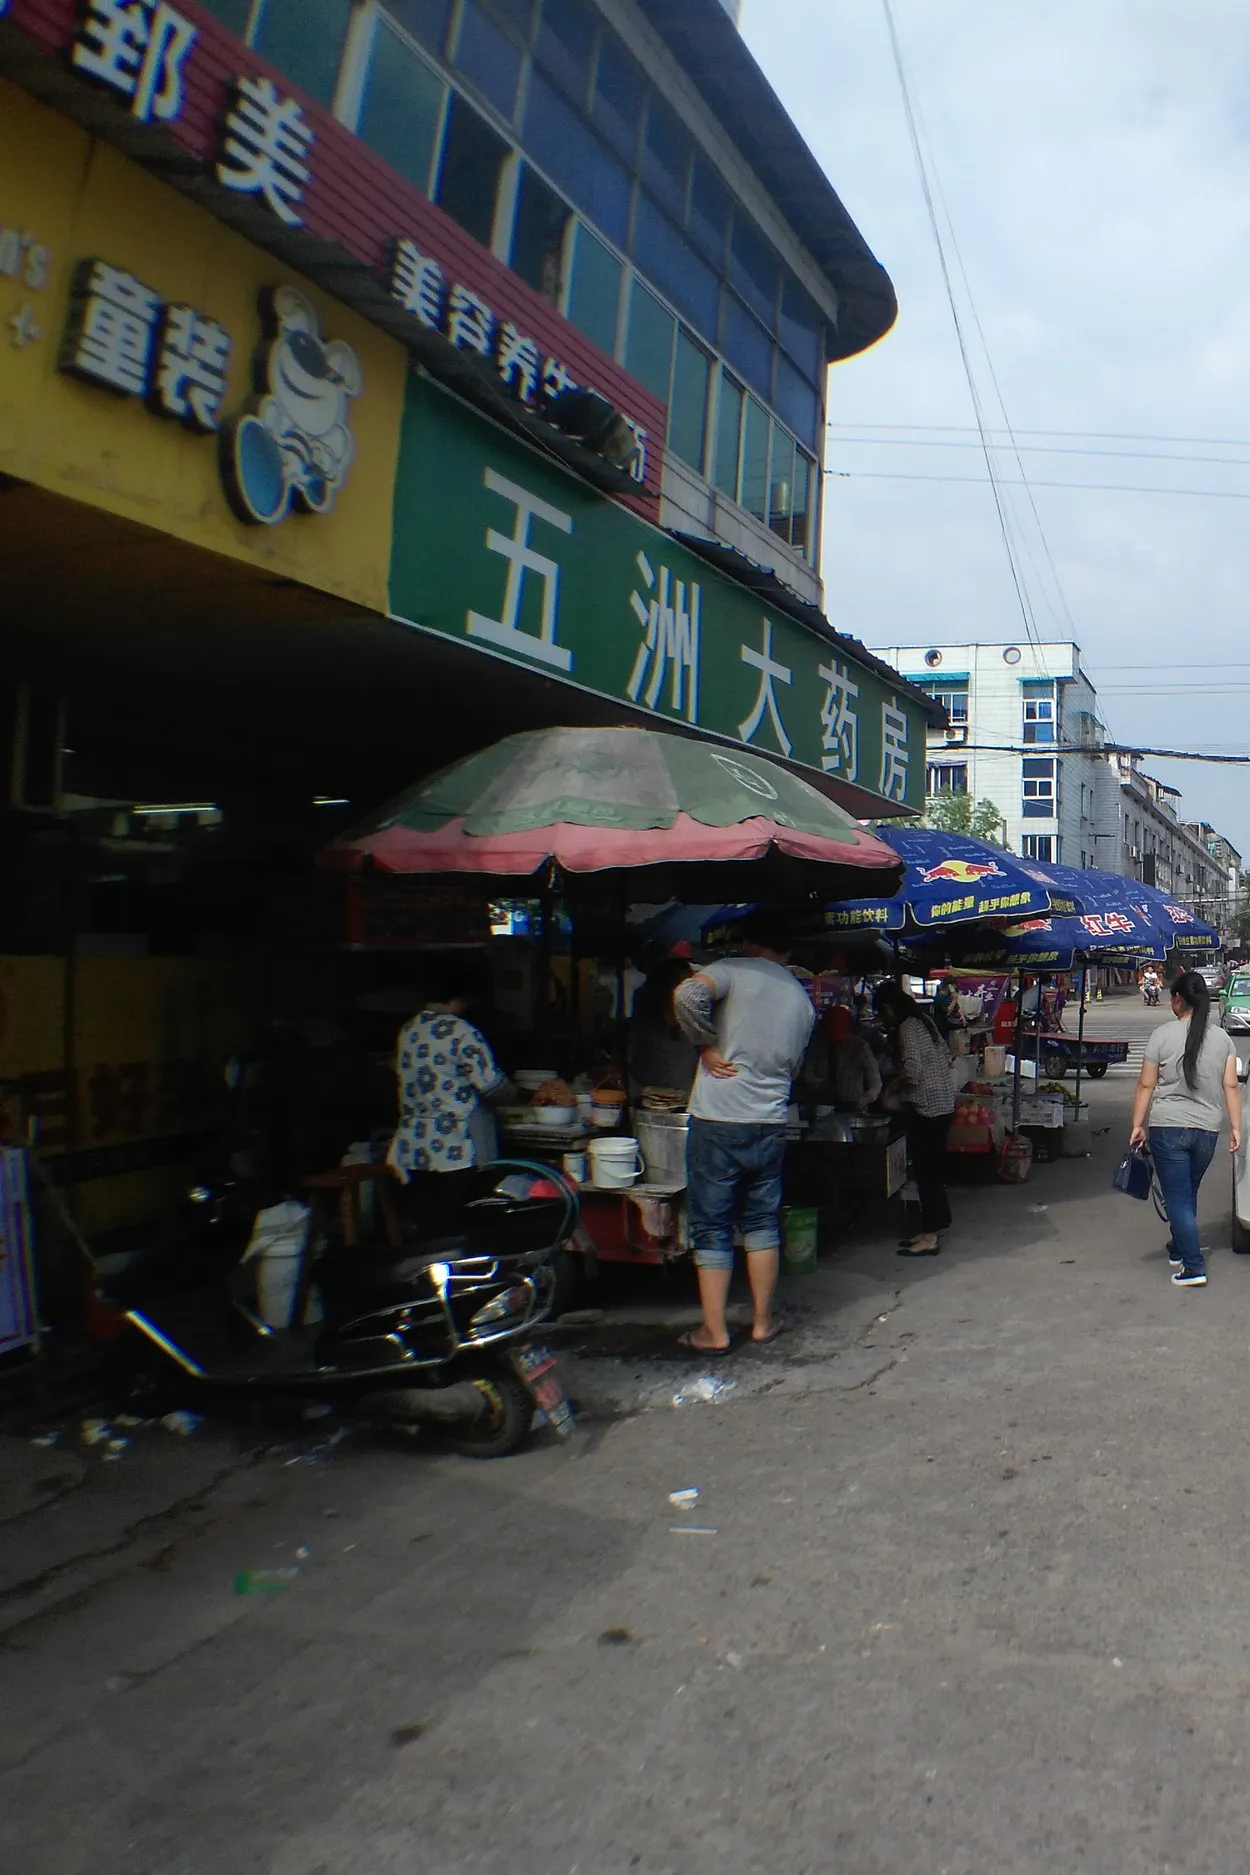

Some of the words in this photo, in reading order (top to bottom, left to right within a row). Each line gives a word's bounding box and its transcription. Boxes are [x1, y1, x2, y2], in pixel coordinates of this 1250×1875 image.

[75, 260, 234, 433] 童装
[466, 467, 910, 802] 五洲大药房
[930, 895, 975, 918] 你的能量
[1080, 911, 1136, 936] 红牛
